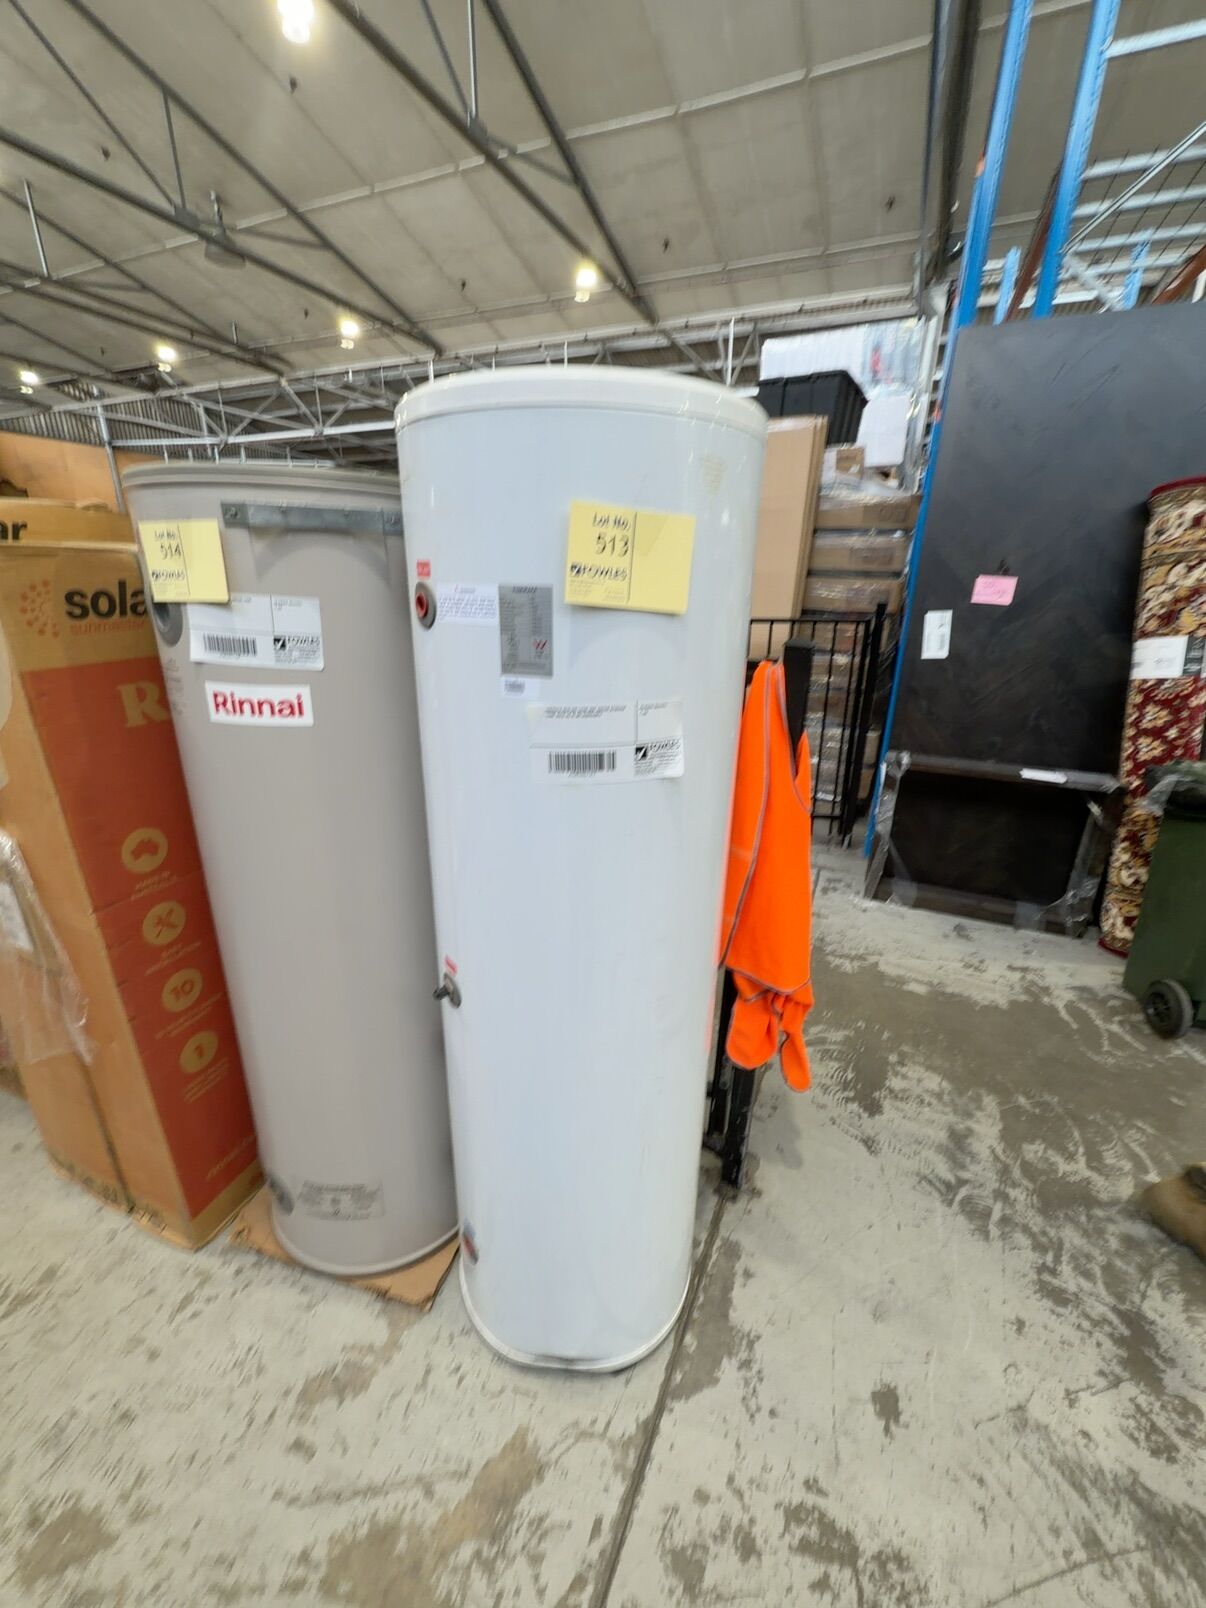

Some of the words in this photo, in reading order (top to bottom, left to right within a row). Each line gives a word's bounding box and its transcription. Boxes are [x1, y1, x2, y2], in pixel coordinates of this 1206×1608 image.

[592, 511, 609, 528] Lot
[160, 542, 182, 560] 514
[595, 532, 629, 557] 513
[582, 564, 628, 582] FOWLES
[212, 690, 305, 719] Rinnai
[170, 979, 195, 1002] 10
